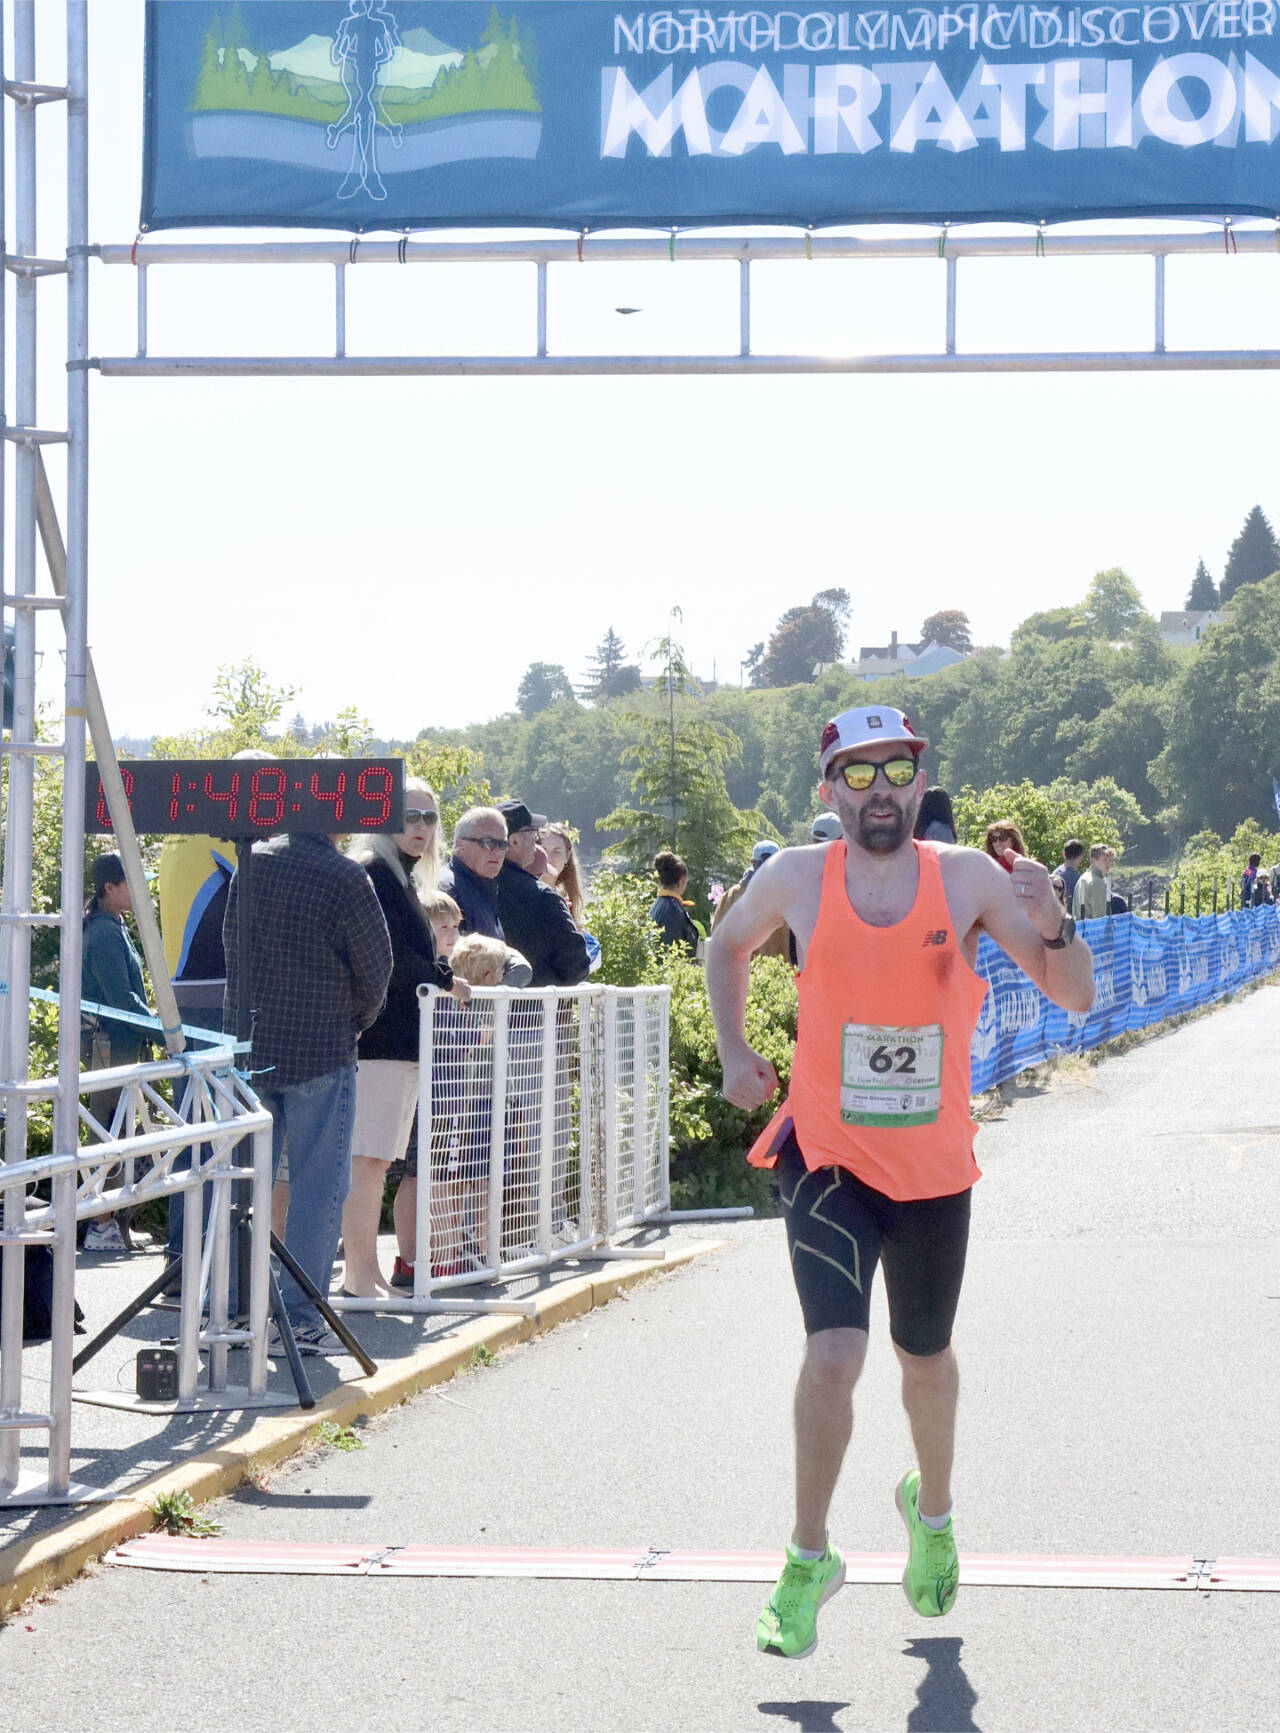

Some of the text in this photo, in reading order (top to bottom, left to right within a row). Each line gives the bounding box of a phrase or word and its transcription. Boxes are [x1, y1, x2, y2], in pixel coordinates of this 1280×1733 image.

[613, 0, 1280, 54] NORTH OLYMPIC DISCOVER
[866, 1033, 924, 1043] MARATHON
[869, 1046, 917, 1073] 62
